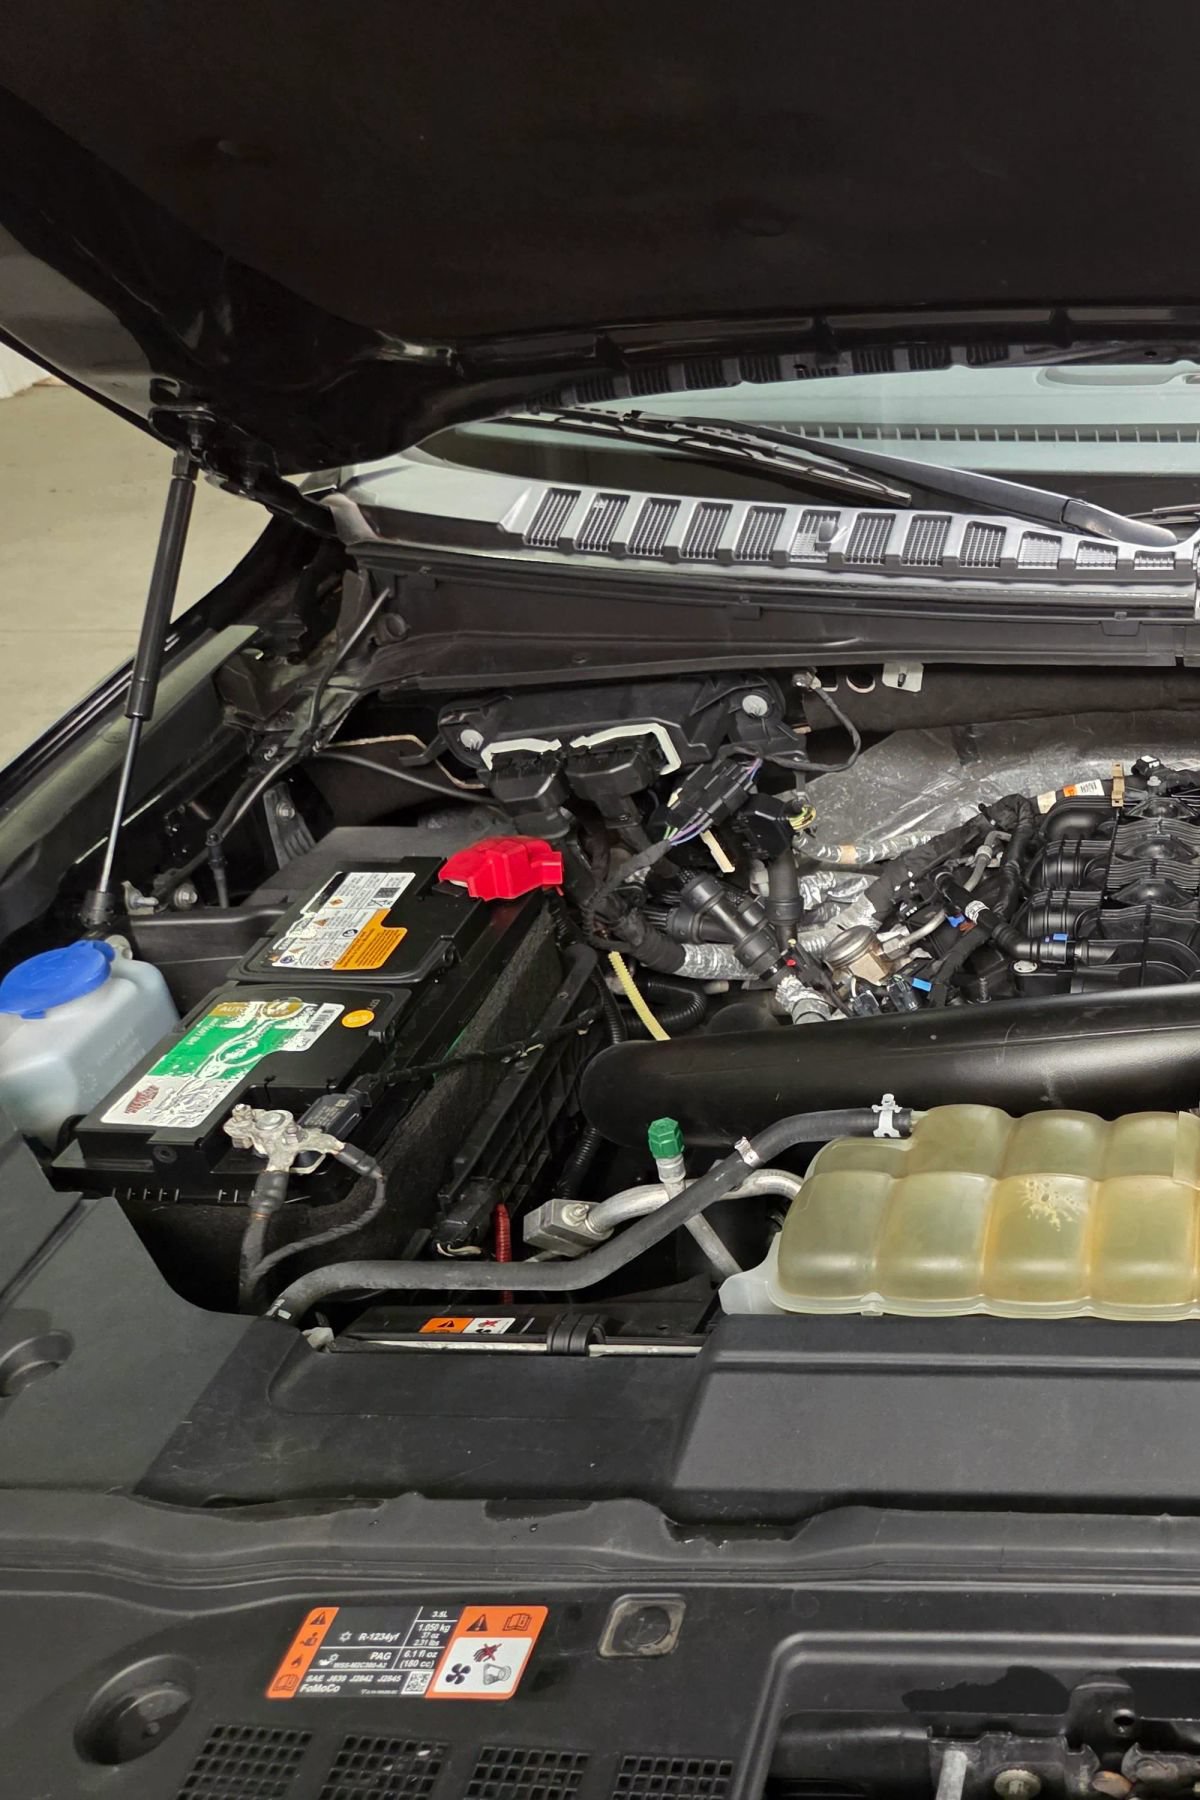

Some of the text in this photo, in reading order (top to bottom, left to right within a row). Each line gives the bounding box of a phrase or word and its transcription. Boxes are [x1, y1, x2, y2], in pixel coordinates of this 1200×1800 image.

[439, 1624, 451, 1633] kg
[358, 1632, 400, 1643] R-1234yf
[369, 1652, 392, 1660] PAG
[419, 1660, 435, 1669] cc)
[300, 1684, 341, 1693] FoMoCo
